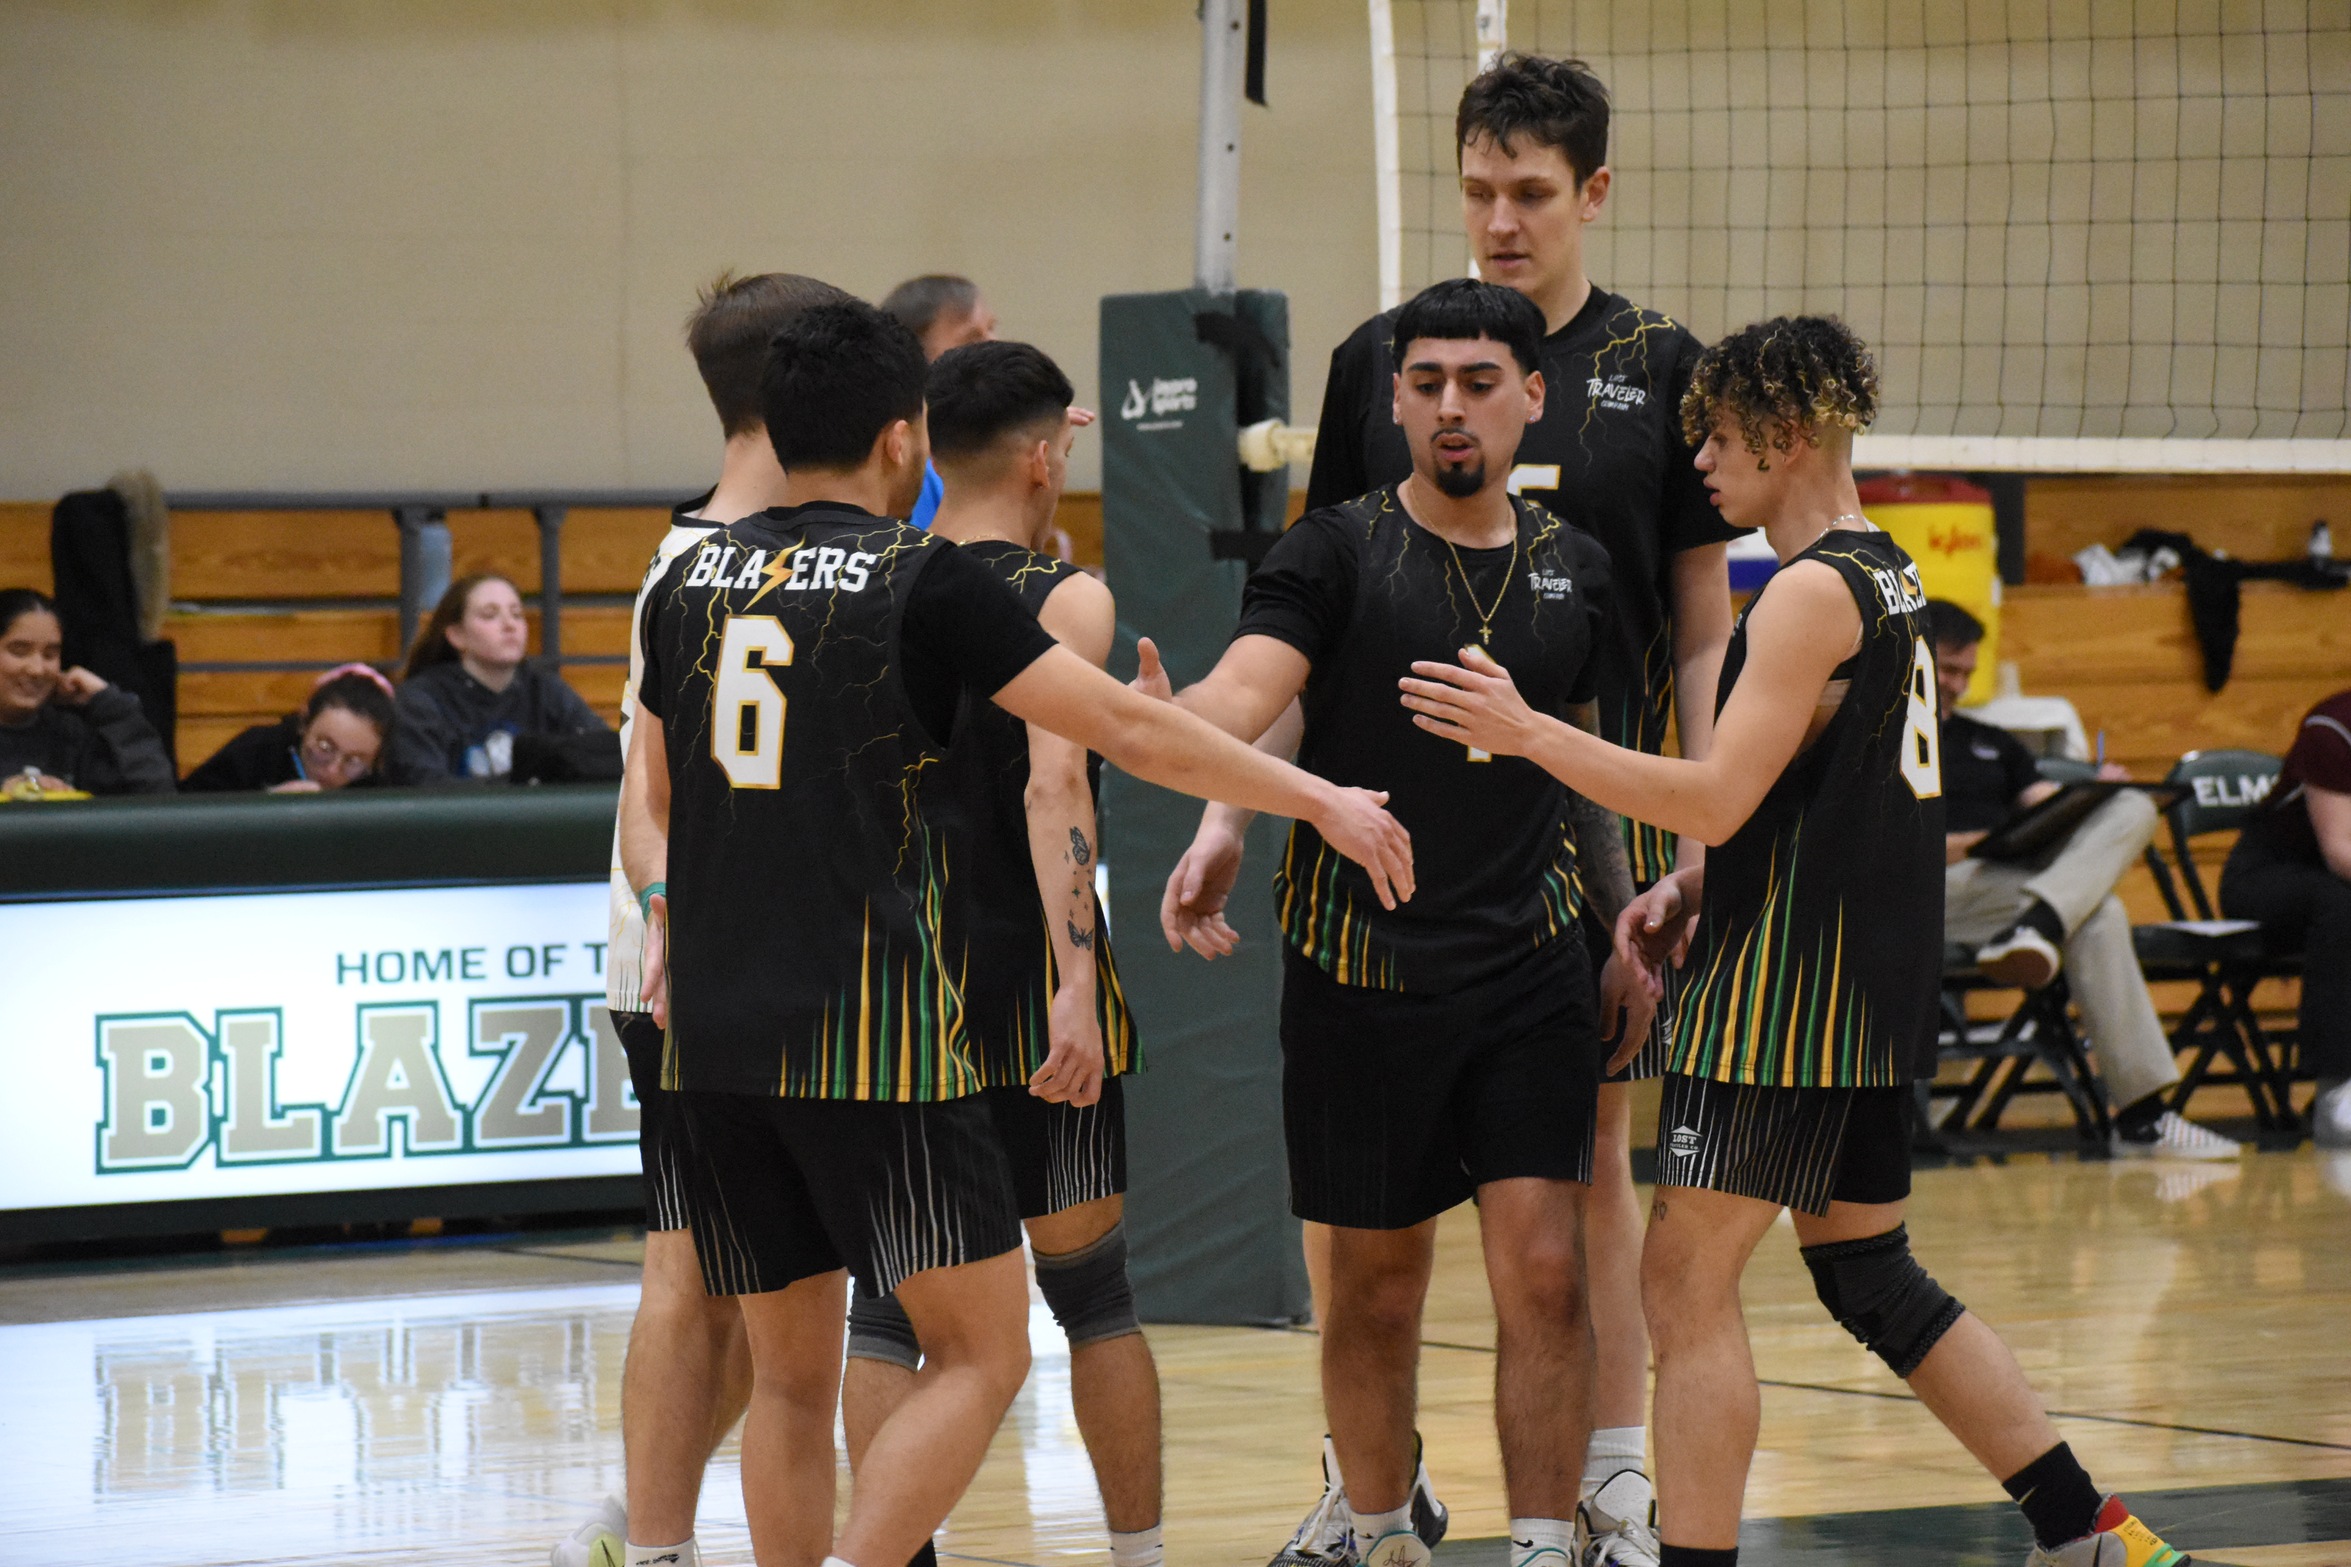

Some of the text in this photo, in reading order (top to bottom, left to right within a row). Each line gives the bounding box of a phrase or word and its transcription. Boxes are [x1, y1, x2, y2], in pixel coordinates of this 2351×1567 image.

[1586, 378, 1646, 405] TRAVELER
[710, 613, 795, 790] 6
[1899, 634, 1942, 800] 8
[2192, 774, 2280, 807] ELM
[336, 946, 487, 985] HOME
[506, 944, 567, 978] OF
